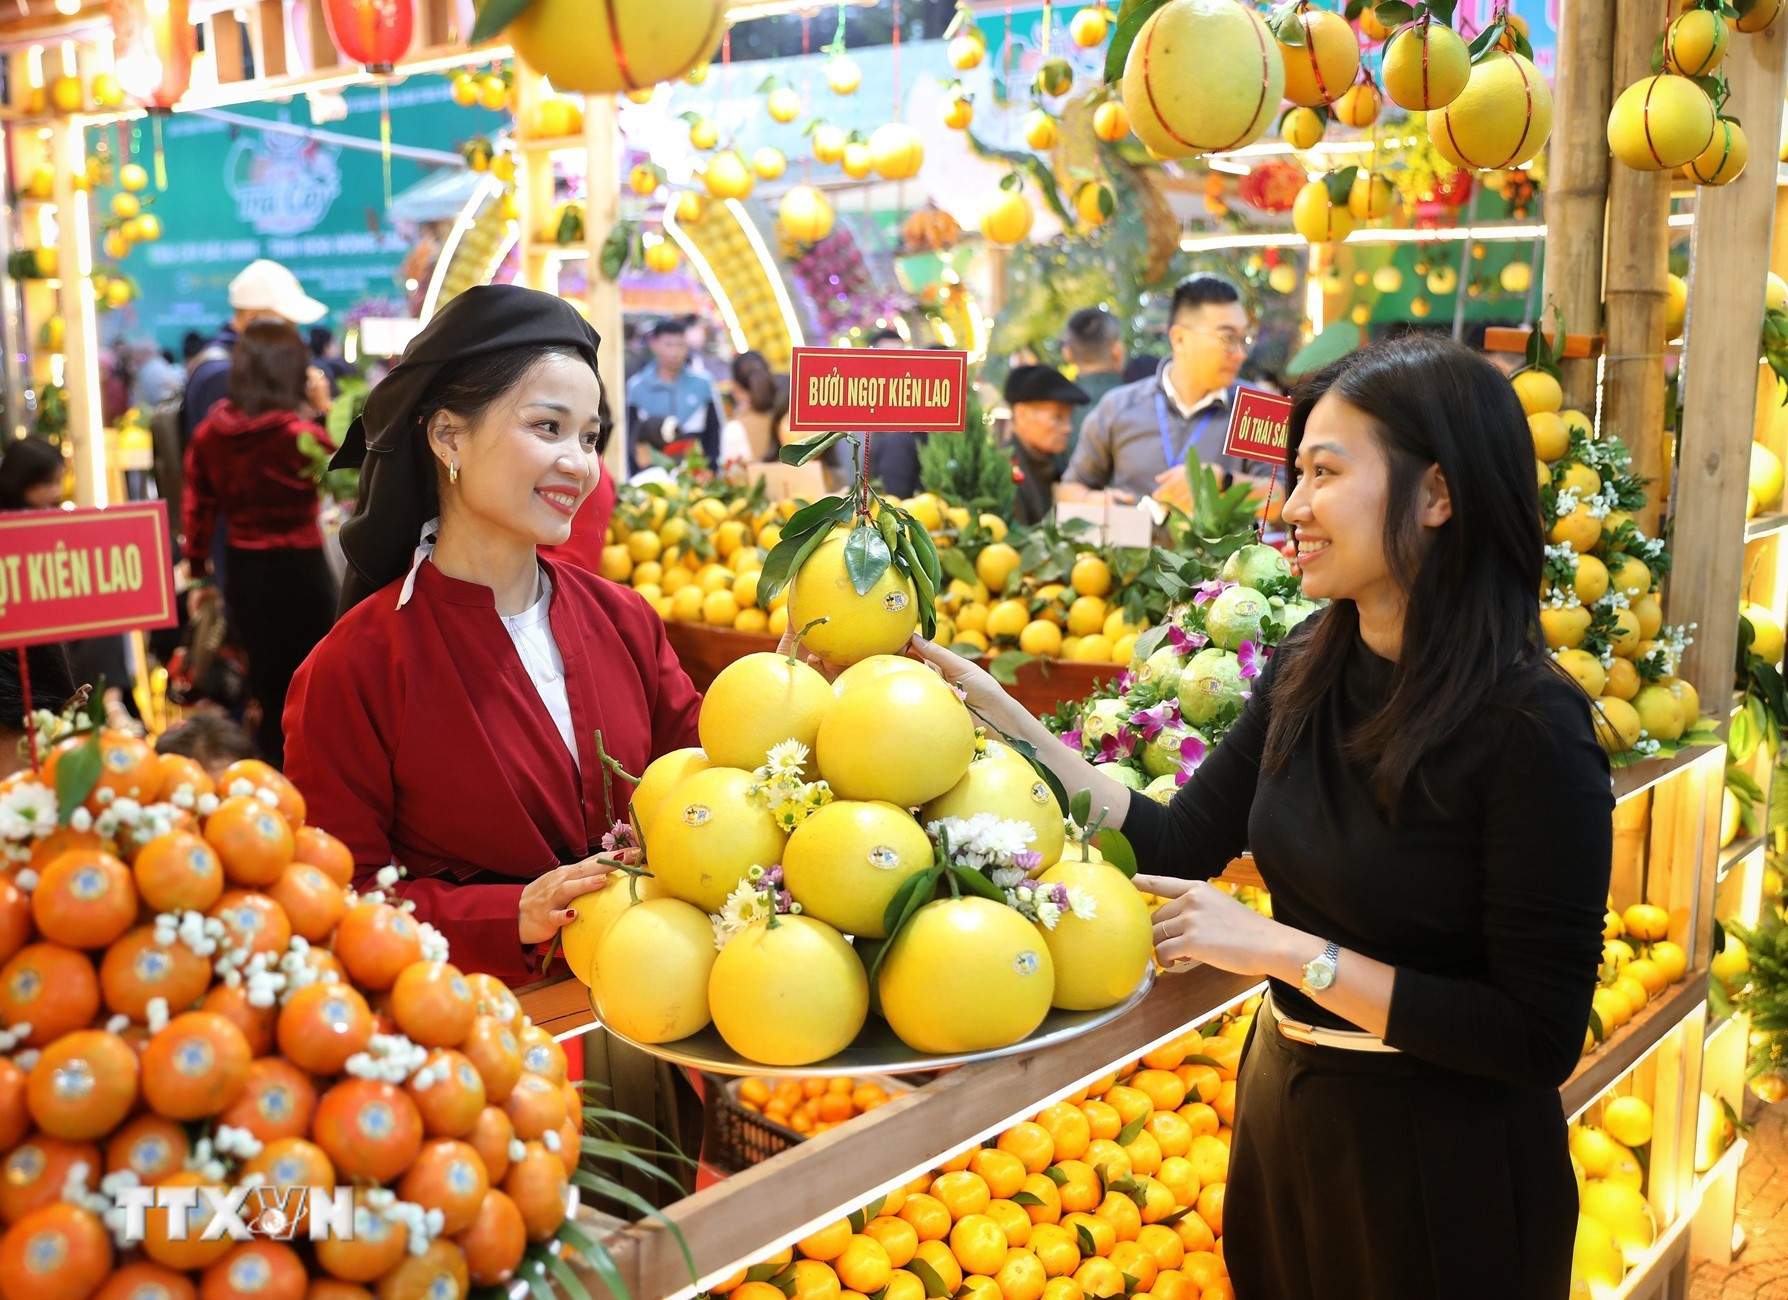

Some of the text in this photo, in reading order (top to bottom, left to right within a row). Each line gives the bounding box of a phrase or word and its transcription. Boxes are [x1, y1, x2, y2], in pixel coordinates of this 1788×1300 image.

[808, 366, 950, 414] BƯỞI NGỌT KIÊN LAO
[1238, 406, 1289, 449] ỔI THÁI SẤ
[27, 539, 91, 602] KIÊN
[94, 543, 143, 595] LAO
